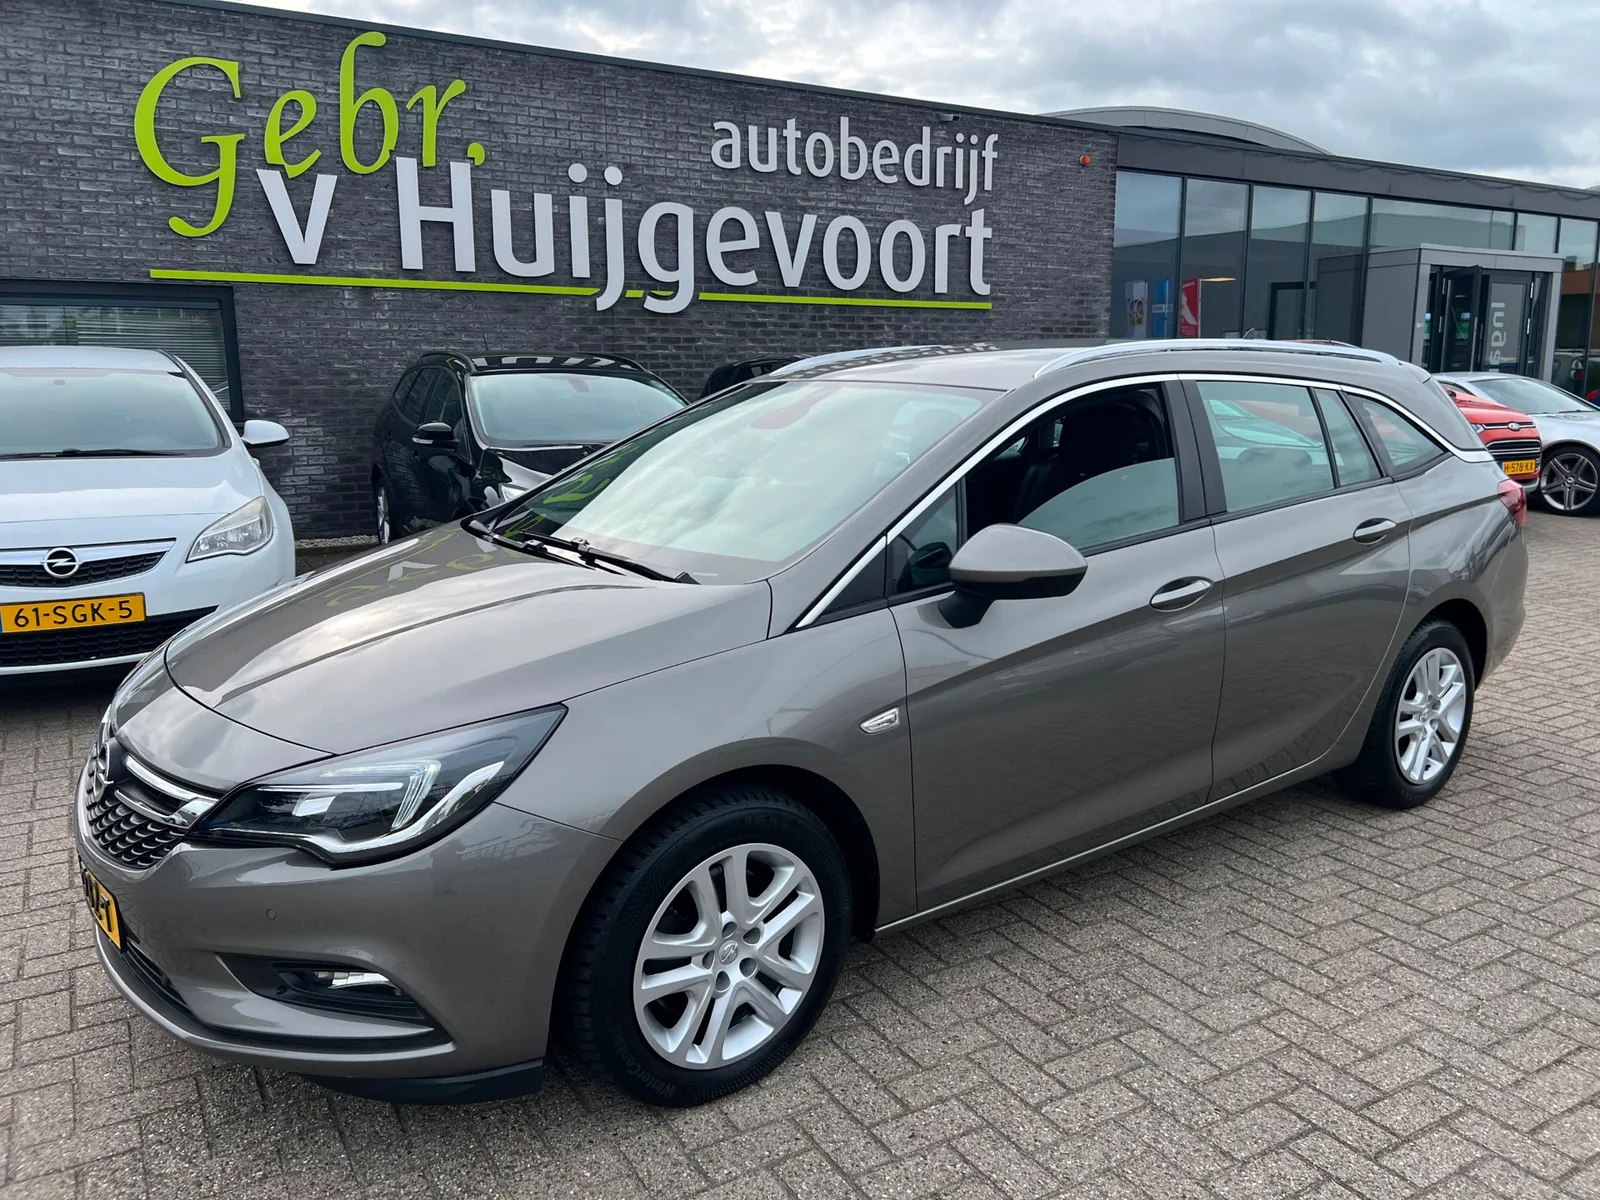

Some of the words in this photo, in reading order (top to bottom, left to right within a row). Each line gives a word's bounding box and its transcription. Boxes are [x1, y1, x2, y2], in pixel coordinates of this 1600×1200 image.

[710, 116, 999, 206] autobedrijf
[256, 168, 338, 265] v
[396, 156, 993, 314] Huijgevoort
[14, 600, 133, 628] 61-SGK-5
